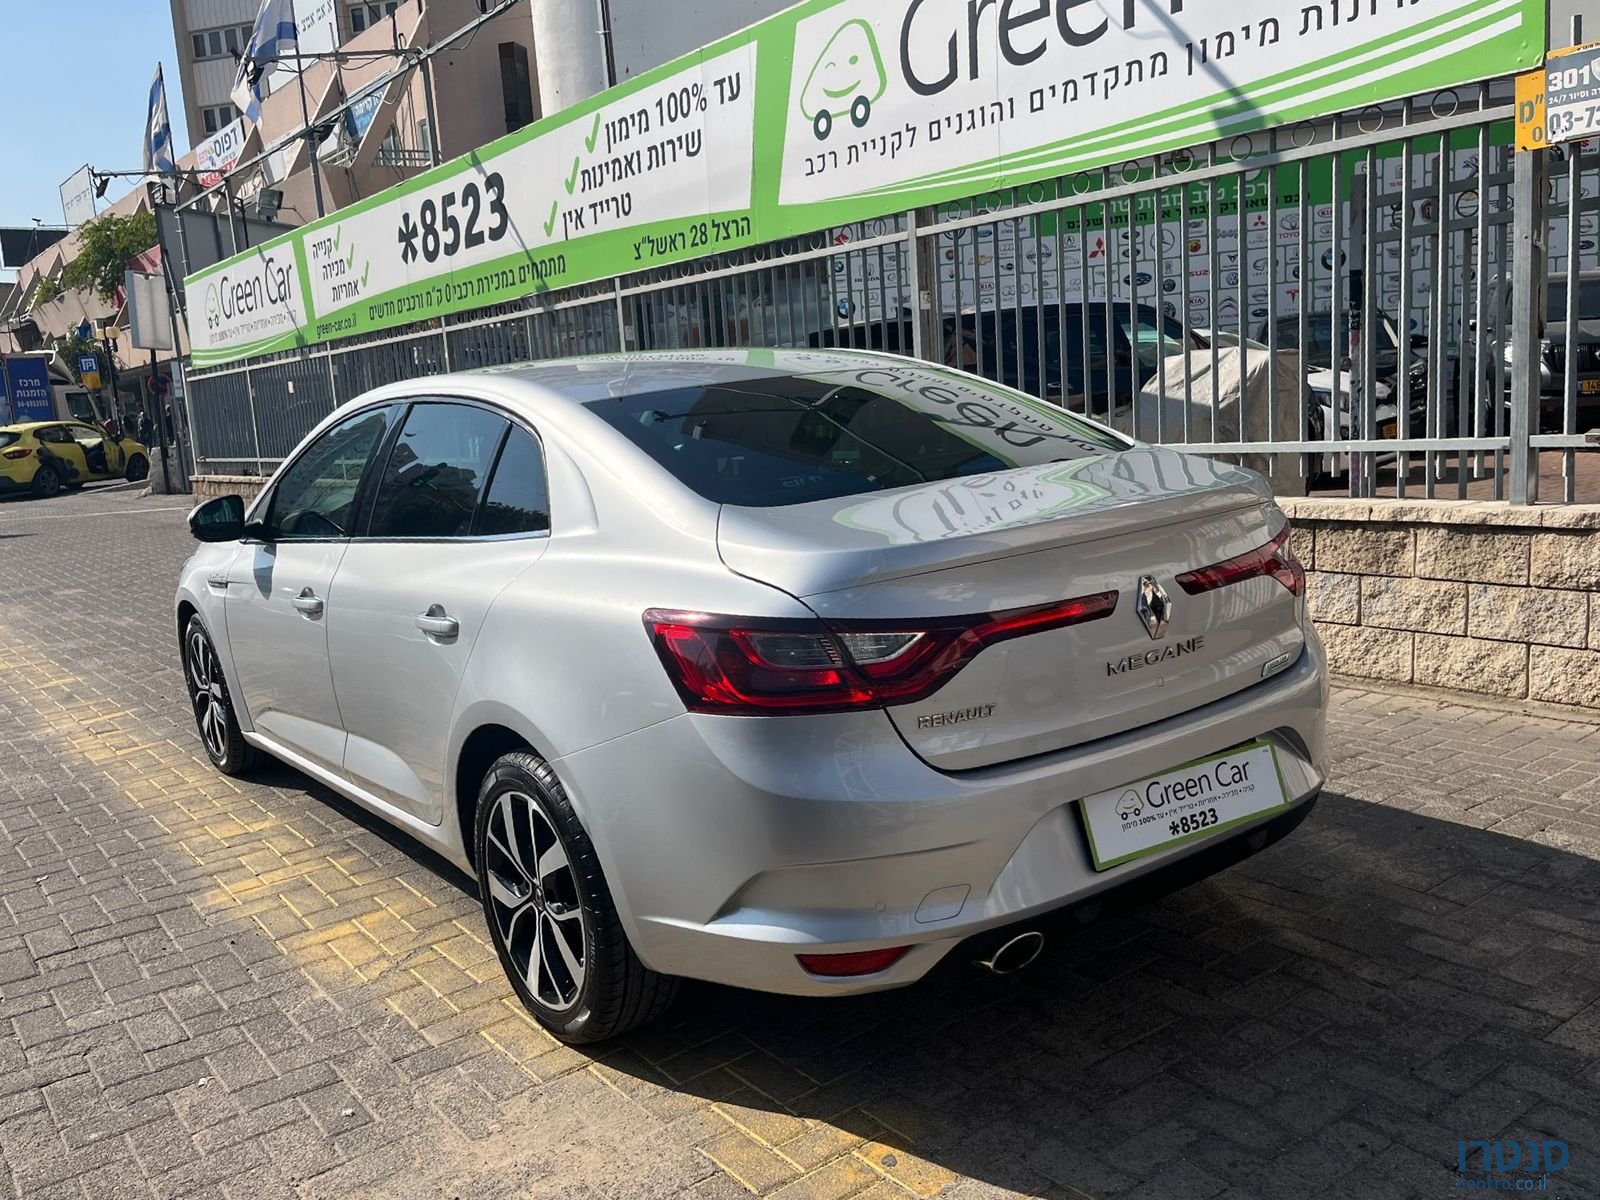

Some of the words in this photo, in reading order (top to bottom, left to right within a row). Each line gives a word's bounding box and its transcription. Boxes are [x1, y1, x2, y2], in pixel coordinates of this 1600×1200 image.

[900, 0, 1182, 96] Gree
[1186, 17, 1280, 76] מימון
[713, 72, 741, 105] עד
[1029, 50, 1169, 114] מתקדמים
[1548, 65, 1590, 93] 301
[655, 82, 707, 127] 100%
[1548, 94, 1566, 105] 24/7
[605, 108, 649, 154] מימון
[928, 96, 1015, 143] והוגנים
[647, 128, 702, 171] שירות
[846, 122, 918, 166] לקניית
[580, 150, 642, 193] ואמינות
[805, 151, 838, 177] רכב
[589, 192, 632, 225] טרייד
[562, 207, 585, 241] אין
[690, 222, 708, 248] 28
[711, 215, 751, 243] הרצל
[312, 237, 332, 260] קנייה
[322, 258, 345, 281] מכירה
[477, 269, 516, 295] במכירת
[519, 254, 567, 282] מתמחים
[220, 275, 264, 320] Green
[264, 257, 292, 305] Car
[332, 280, 360, 303] אחריות
[453, 278, 474, 300] רכבי
[369, 300, 395, 321] חדשים
[397, 294, 424, 314] ורכבים
[16, 389, 47, 398] הזמנות
[18, 378, 41, 387] מרכז
[1106, 635, 1205, 677] MEGANE
[918, 703, 997, 729] RENAULT
[1146, 774, 1212, 809] Green
[1215, 761, 1250, 788] Car
